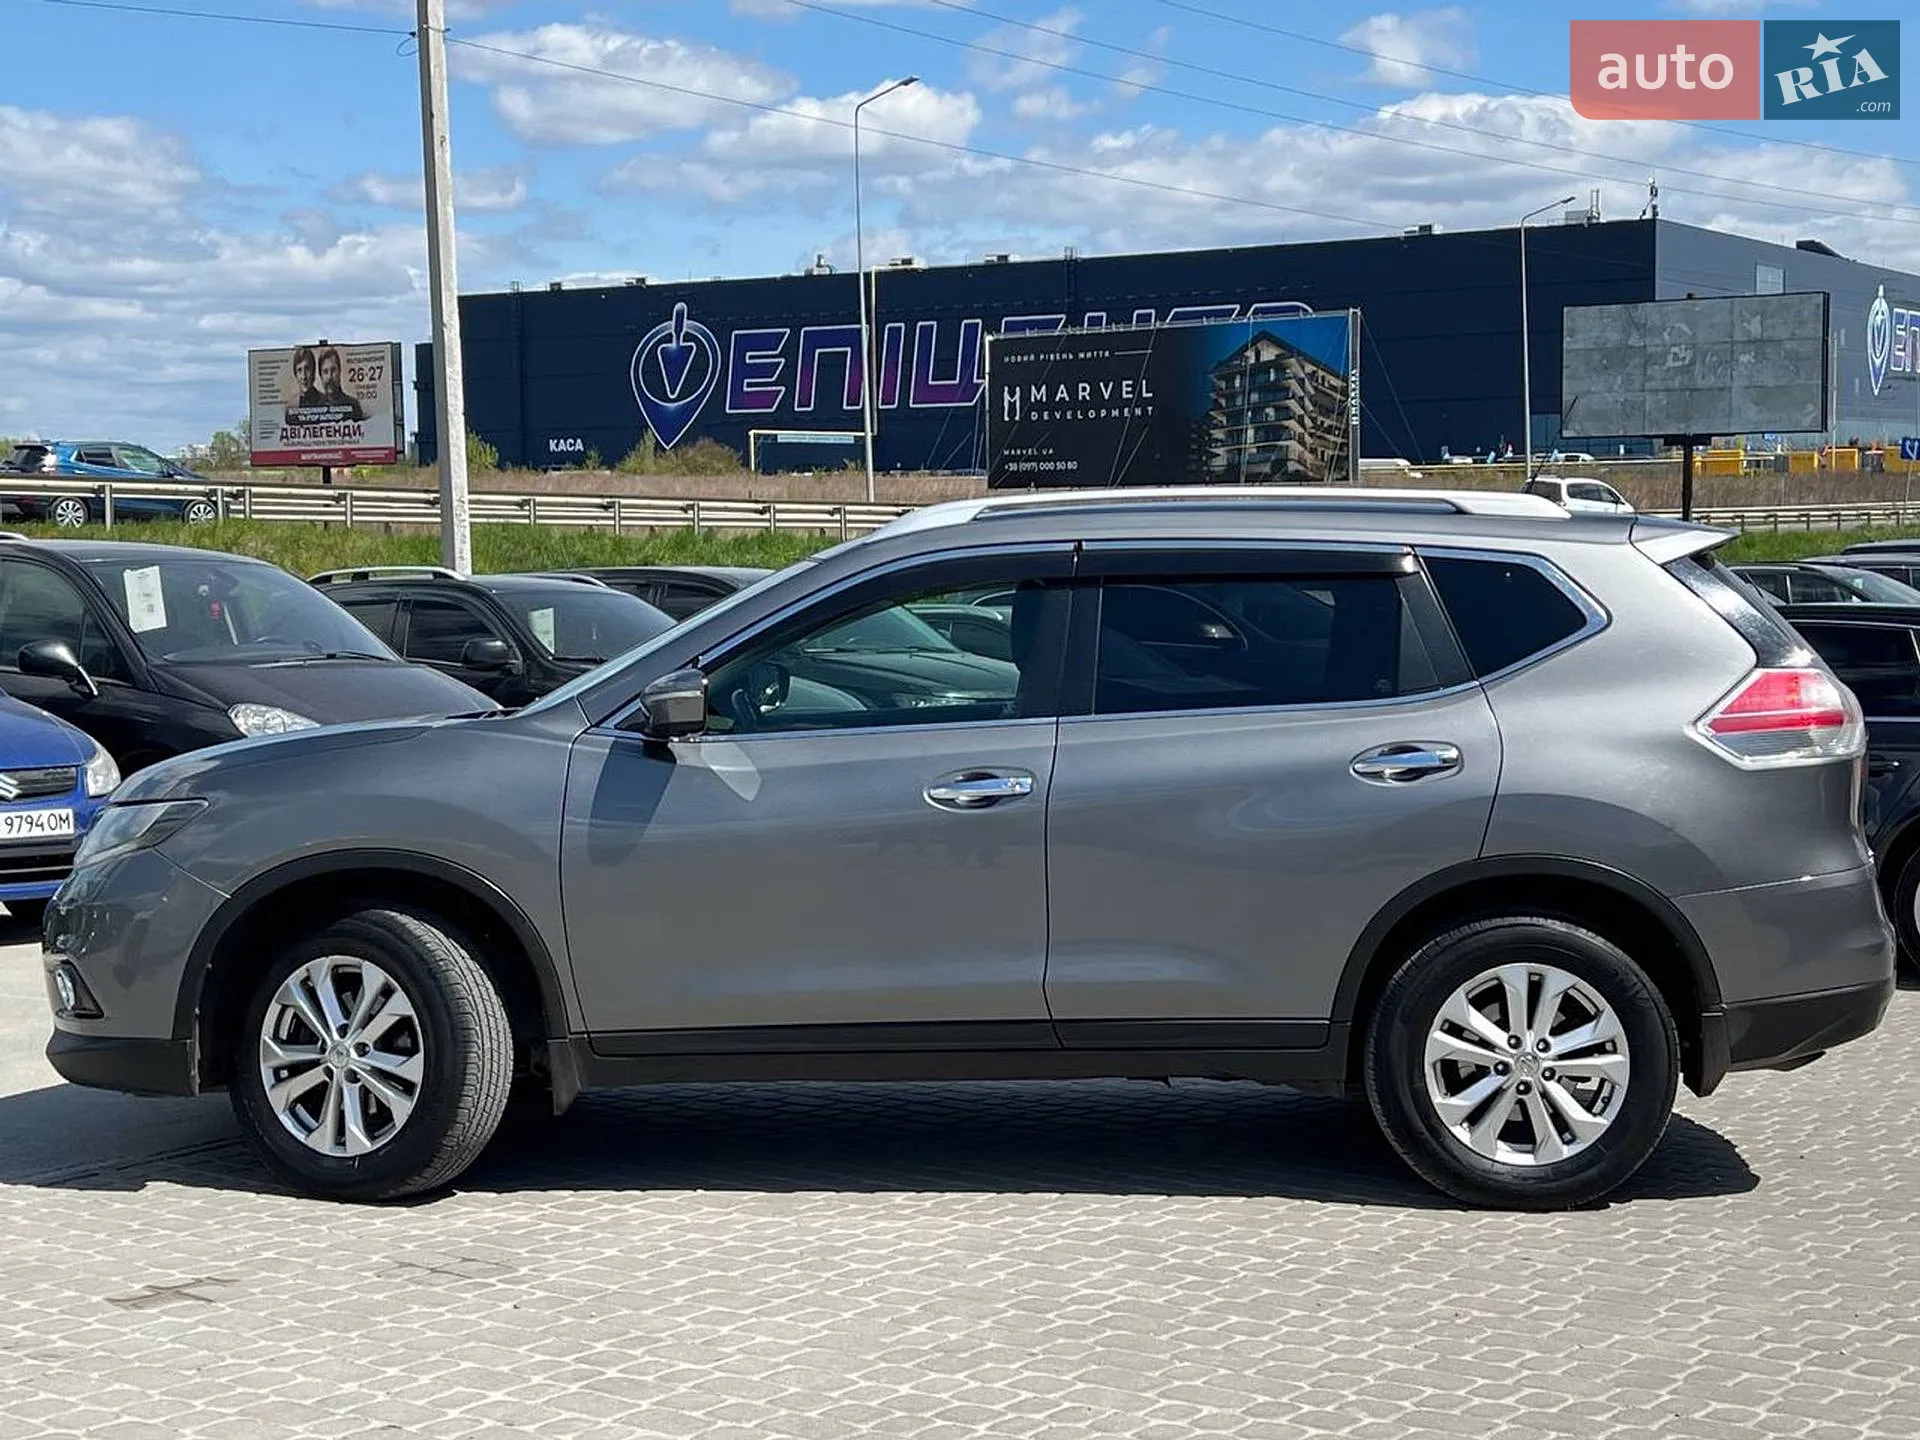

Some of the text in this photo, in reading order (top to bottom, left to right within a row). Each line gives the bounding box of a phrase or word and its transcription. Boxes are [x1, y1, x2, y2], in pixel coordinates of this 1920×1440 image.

[1031, 379, 1154, 403] MARVEL
[1031, 406, 1154, 422] DEVELOPMENT
[549, 438, 585, 453] КАСА
